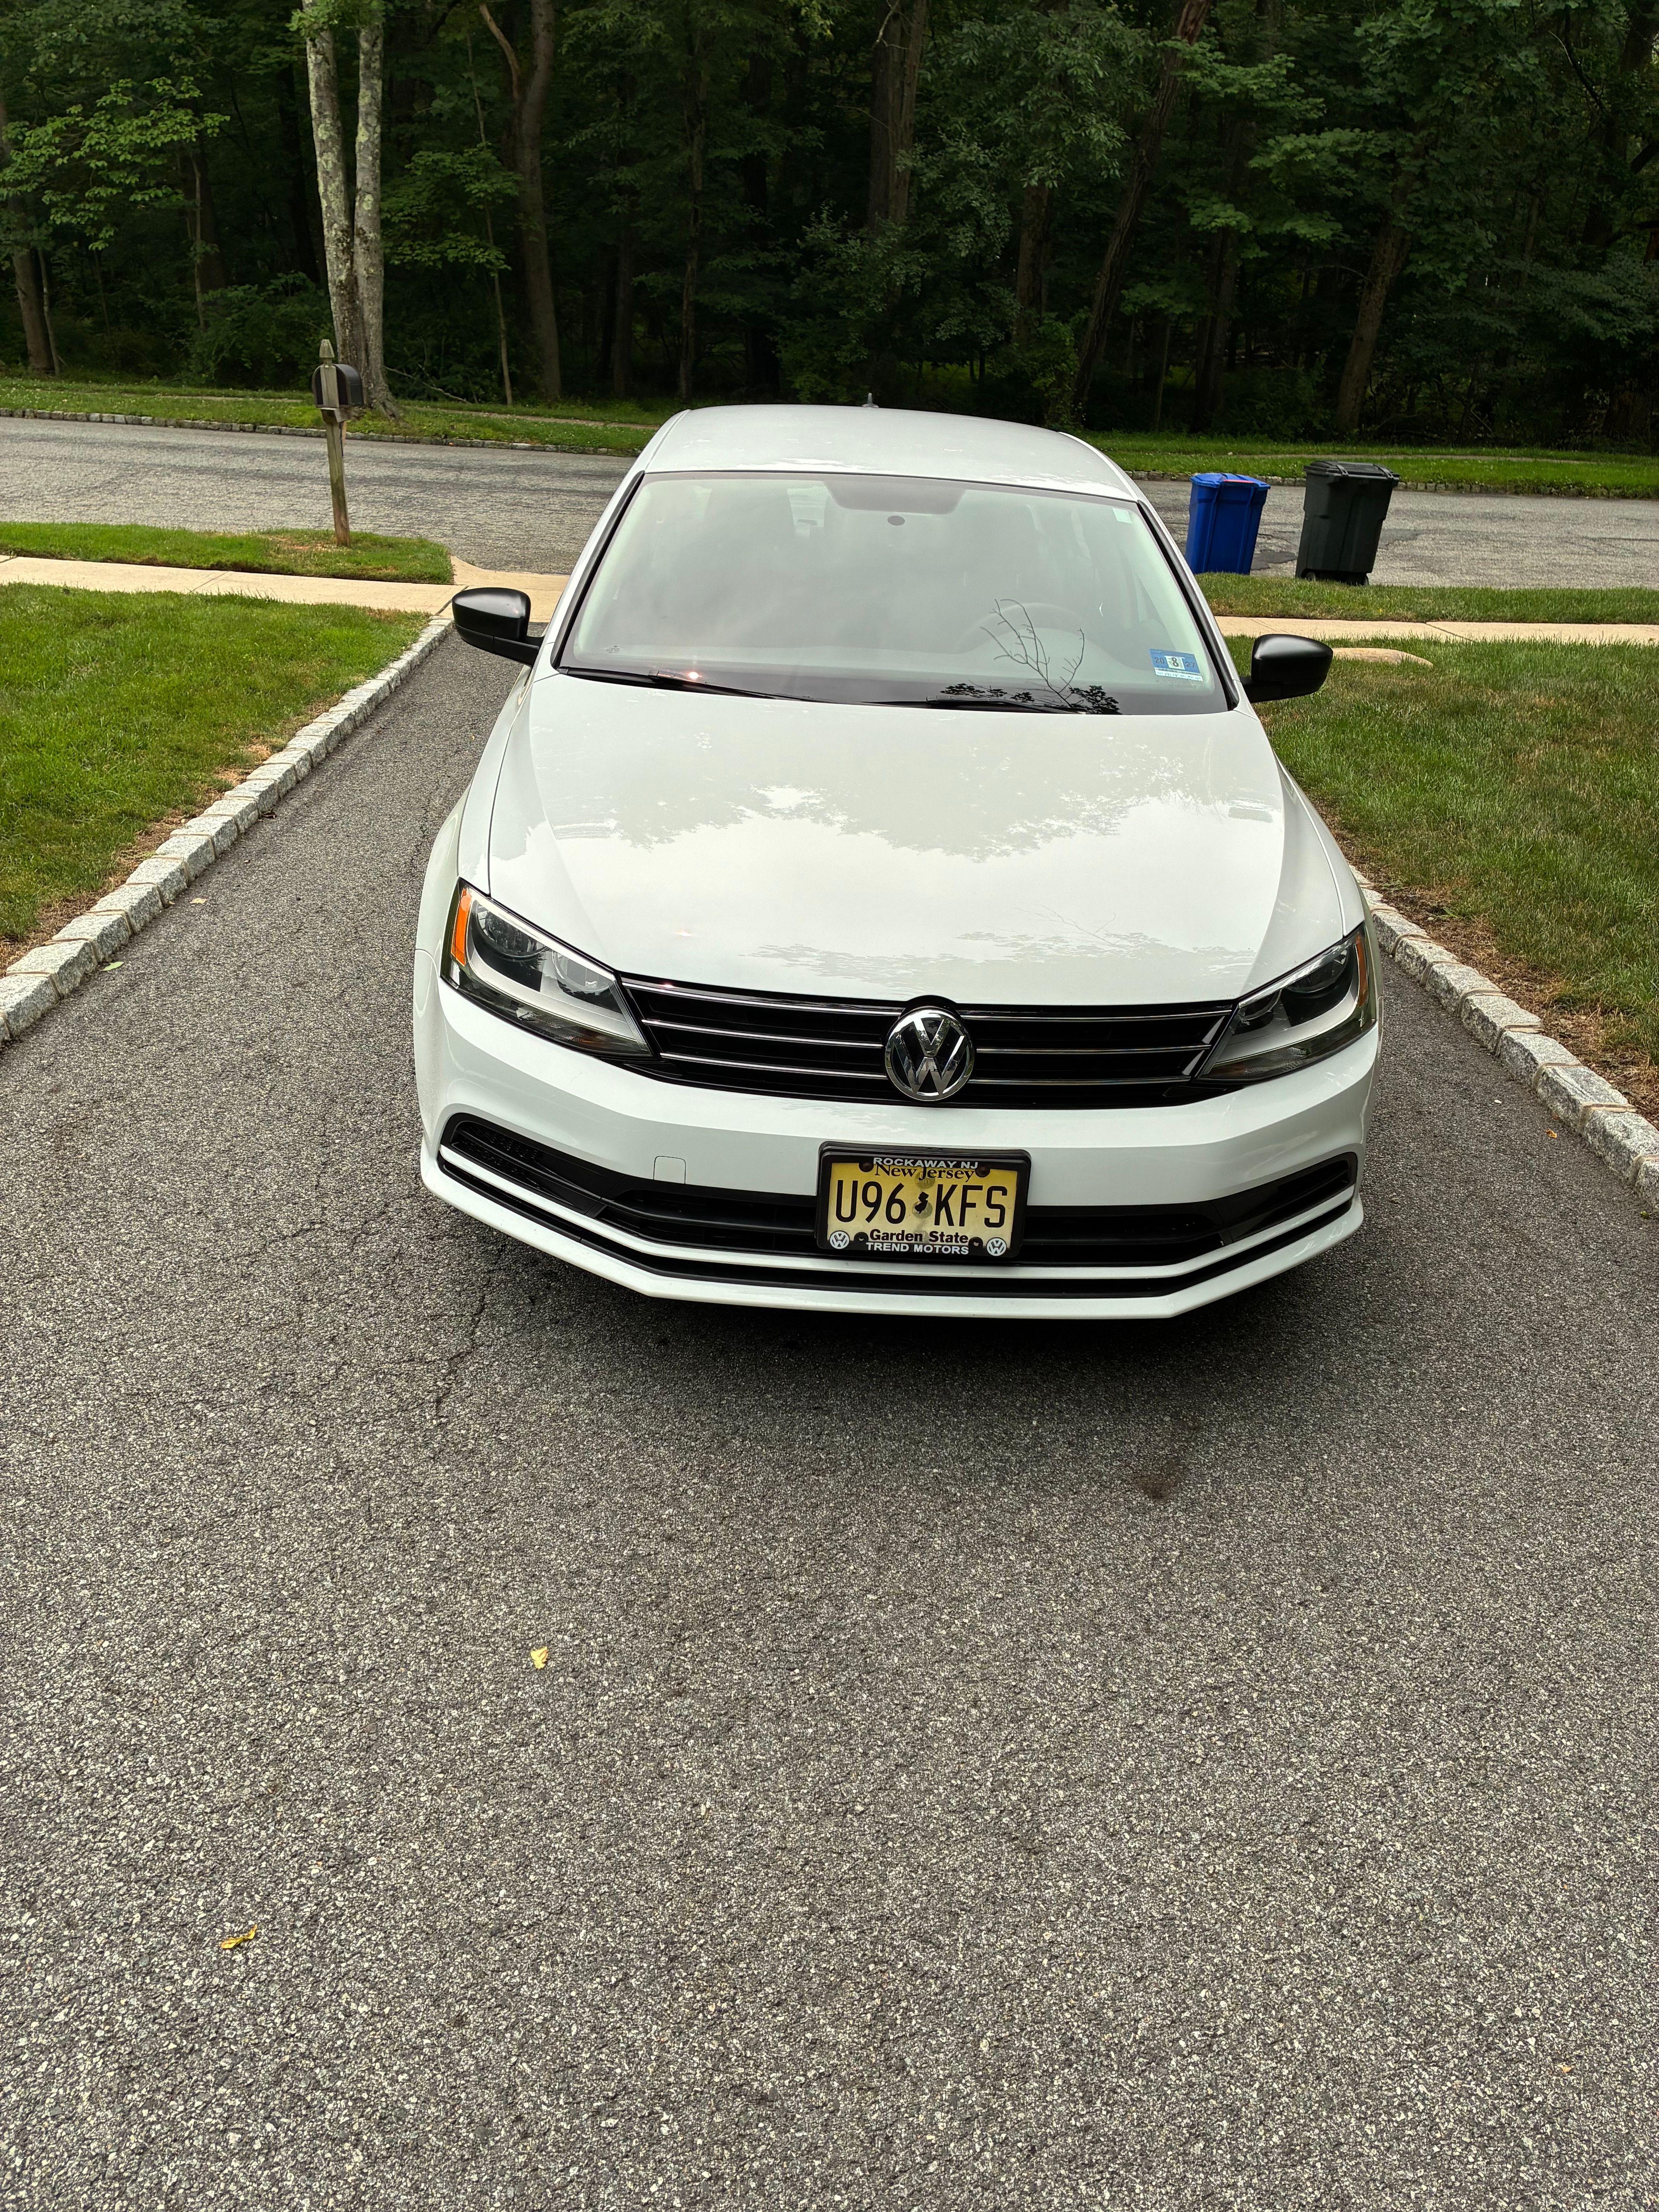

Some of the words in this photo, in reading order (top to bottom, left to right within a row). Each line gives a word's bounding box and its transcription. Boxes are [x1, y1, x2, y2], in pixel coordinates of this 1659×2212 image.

[1171, 657, 1179, 667] 8
[873, 1157, 957, 1169] ROCKAWAY
[874, 1164, 917, 1177] New
[919, 1167, 975, 1182] Jersey
[835, 1180, 906, 1224] U96
[934, 1184, 1008, 1228] KFS
[870, 1229, 923, 1242] Garden
[929, 1231, 969, 1243] State
[866, 1242, 909, 1252] TREND
[914, 1244, 969, 1255] MOTORS
